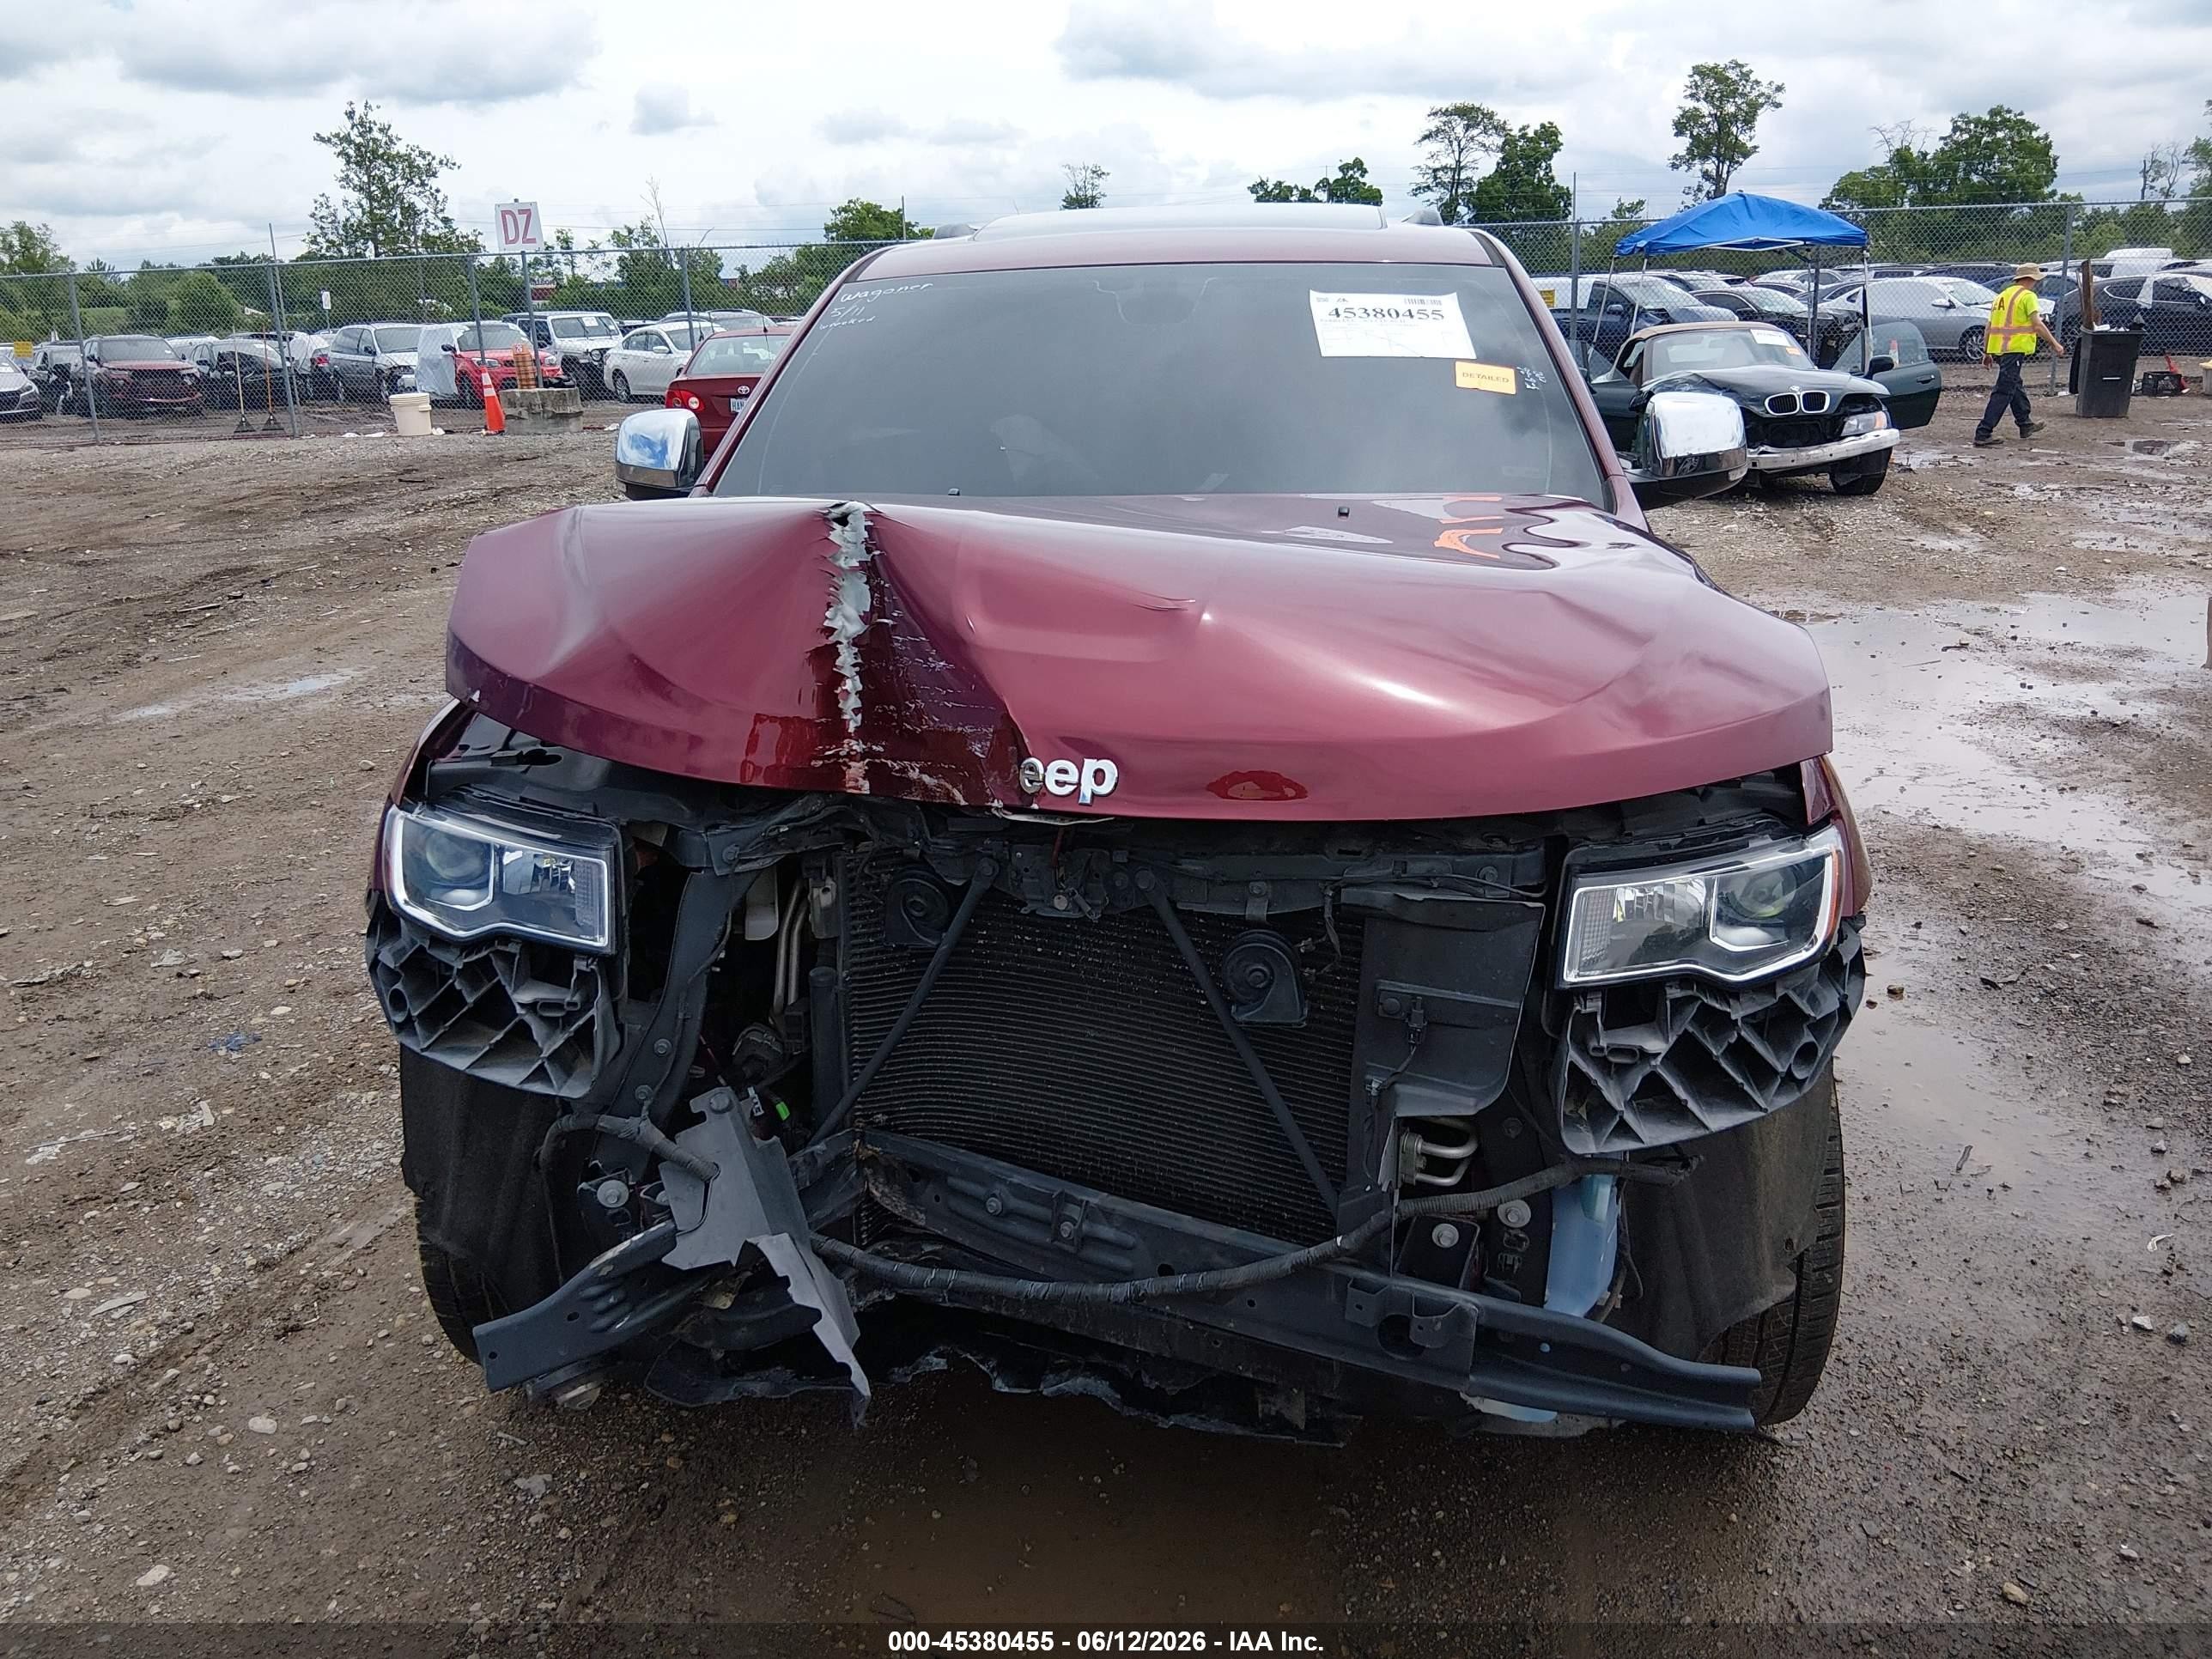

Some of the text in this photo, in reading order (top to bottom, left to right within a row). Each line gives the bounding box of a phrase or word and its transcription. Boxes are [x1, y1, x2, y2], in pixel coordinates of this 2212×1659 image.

[501, 208, 537, 245] DZ
[1328, 307, 1445, 320] 45380455
[1462, 372, 1510, 383] DETAILED
